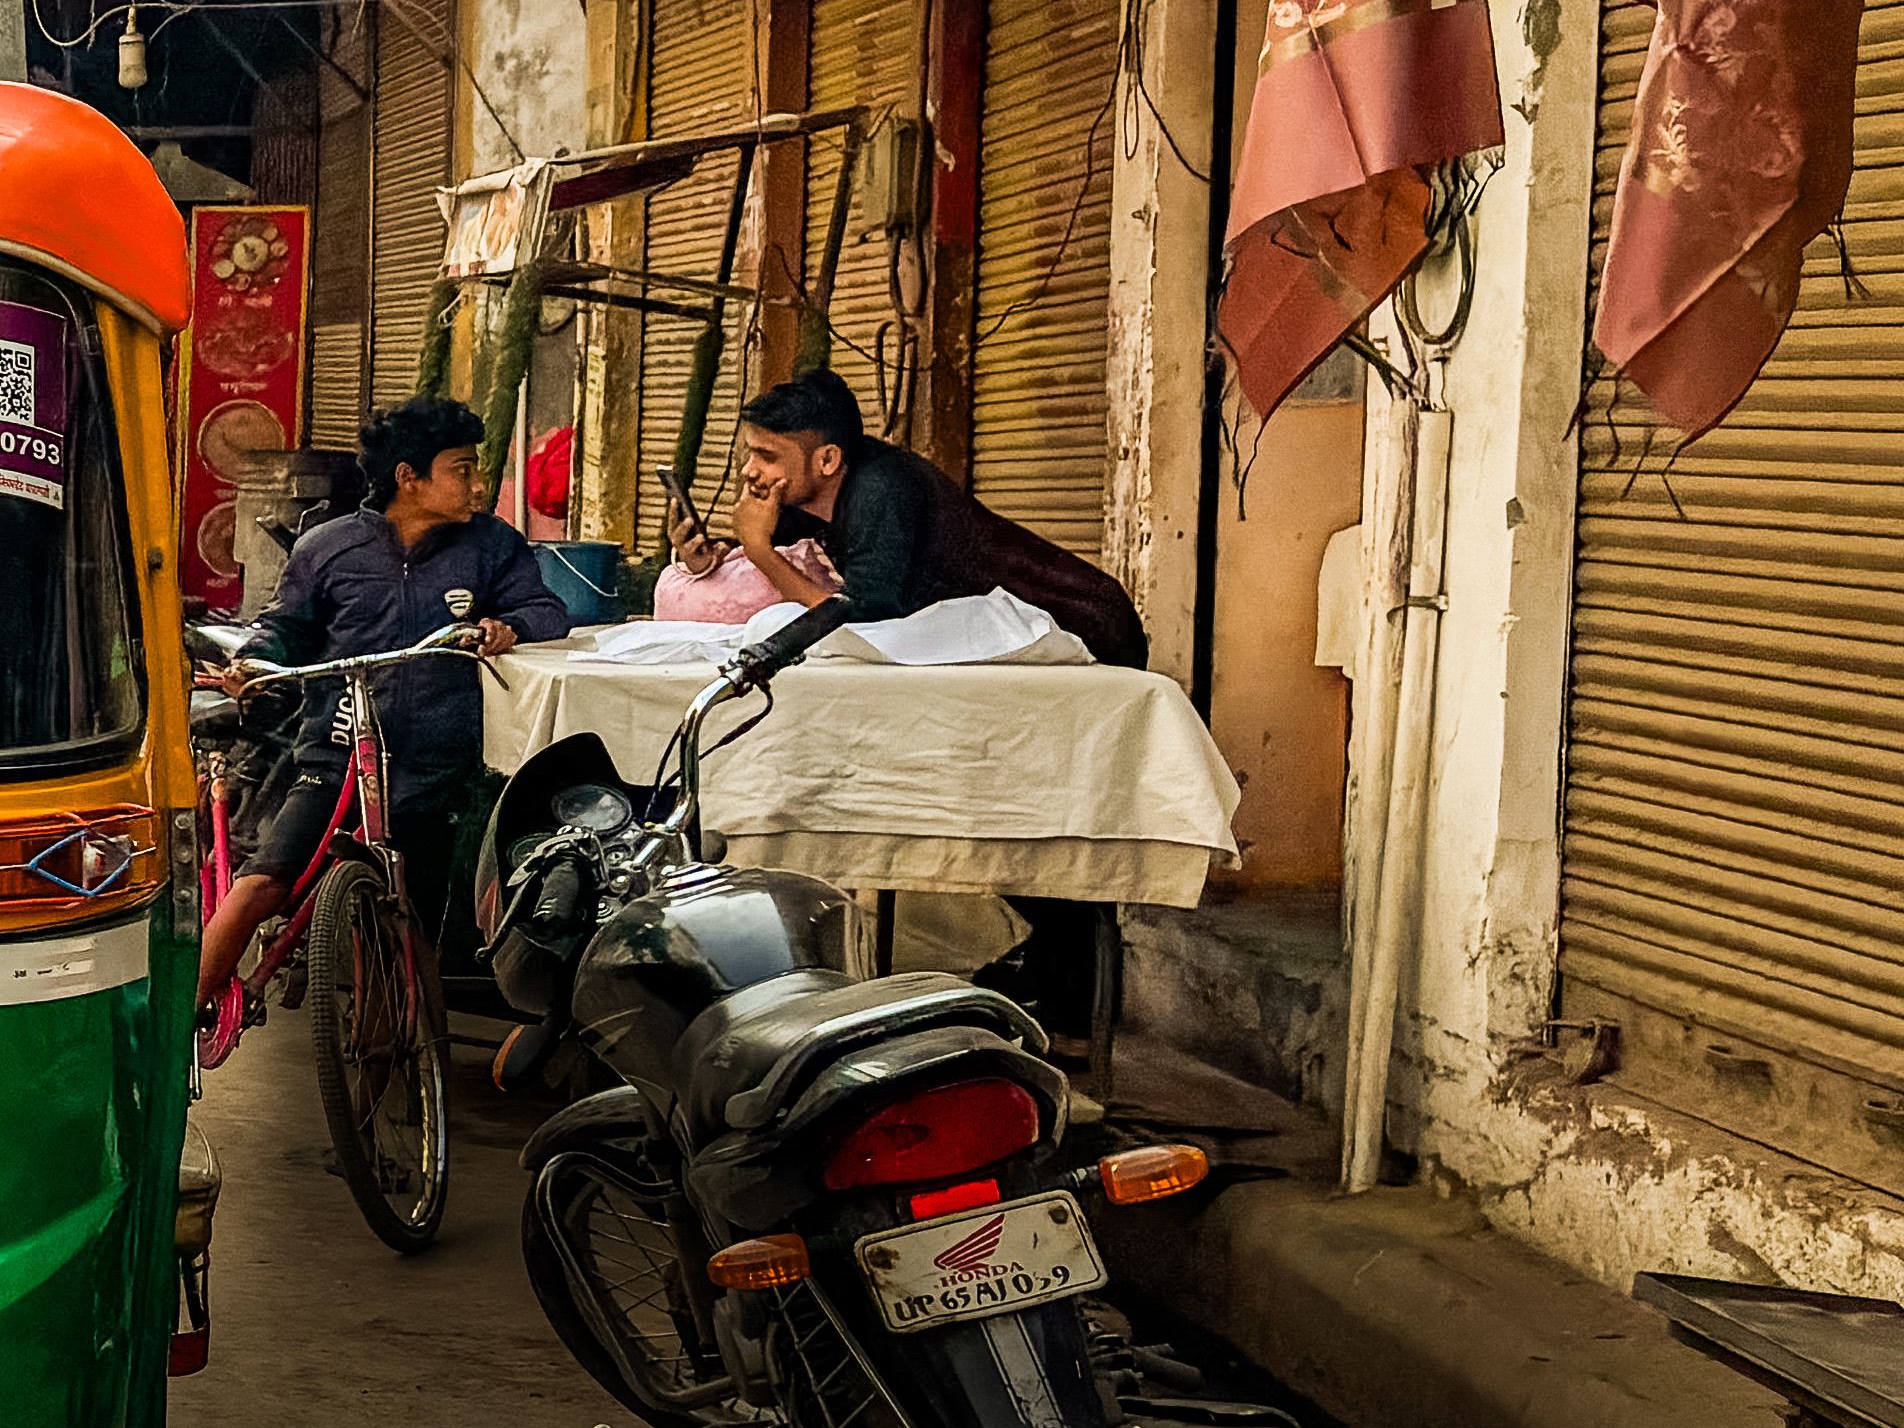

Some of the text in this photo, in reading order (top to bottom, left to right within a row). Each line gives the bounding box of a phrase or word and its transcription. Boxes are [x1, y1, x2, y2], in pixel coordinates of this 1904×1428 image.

[0, 431, 60, 465] 0793
[330, 684, 353, 746] DUC
[939, 1260, 1025, 1289] HONDA
[893, 1294, 935, 1322] UP
[939, 1286, 972, 1310] 65
